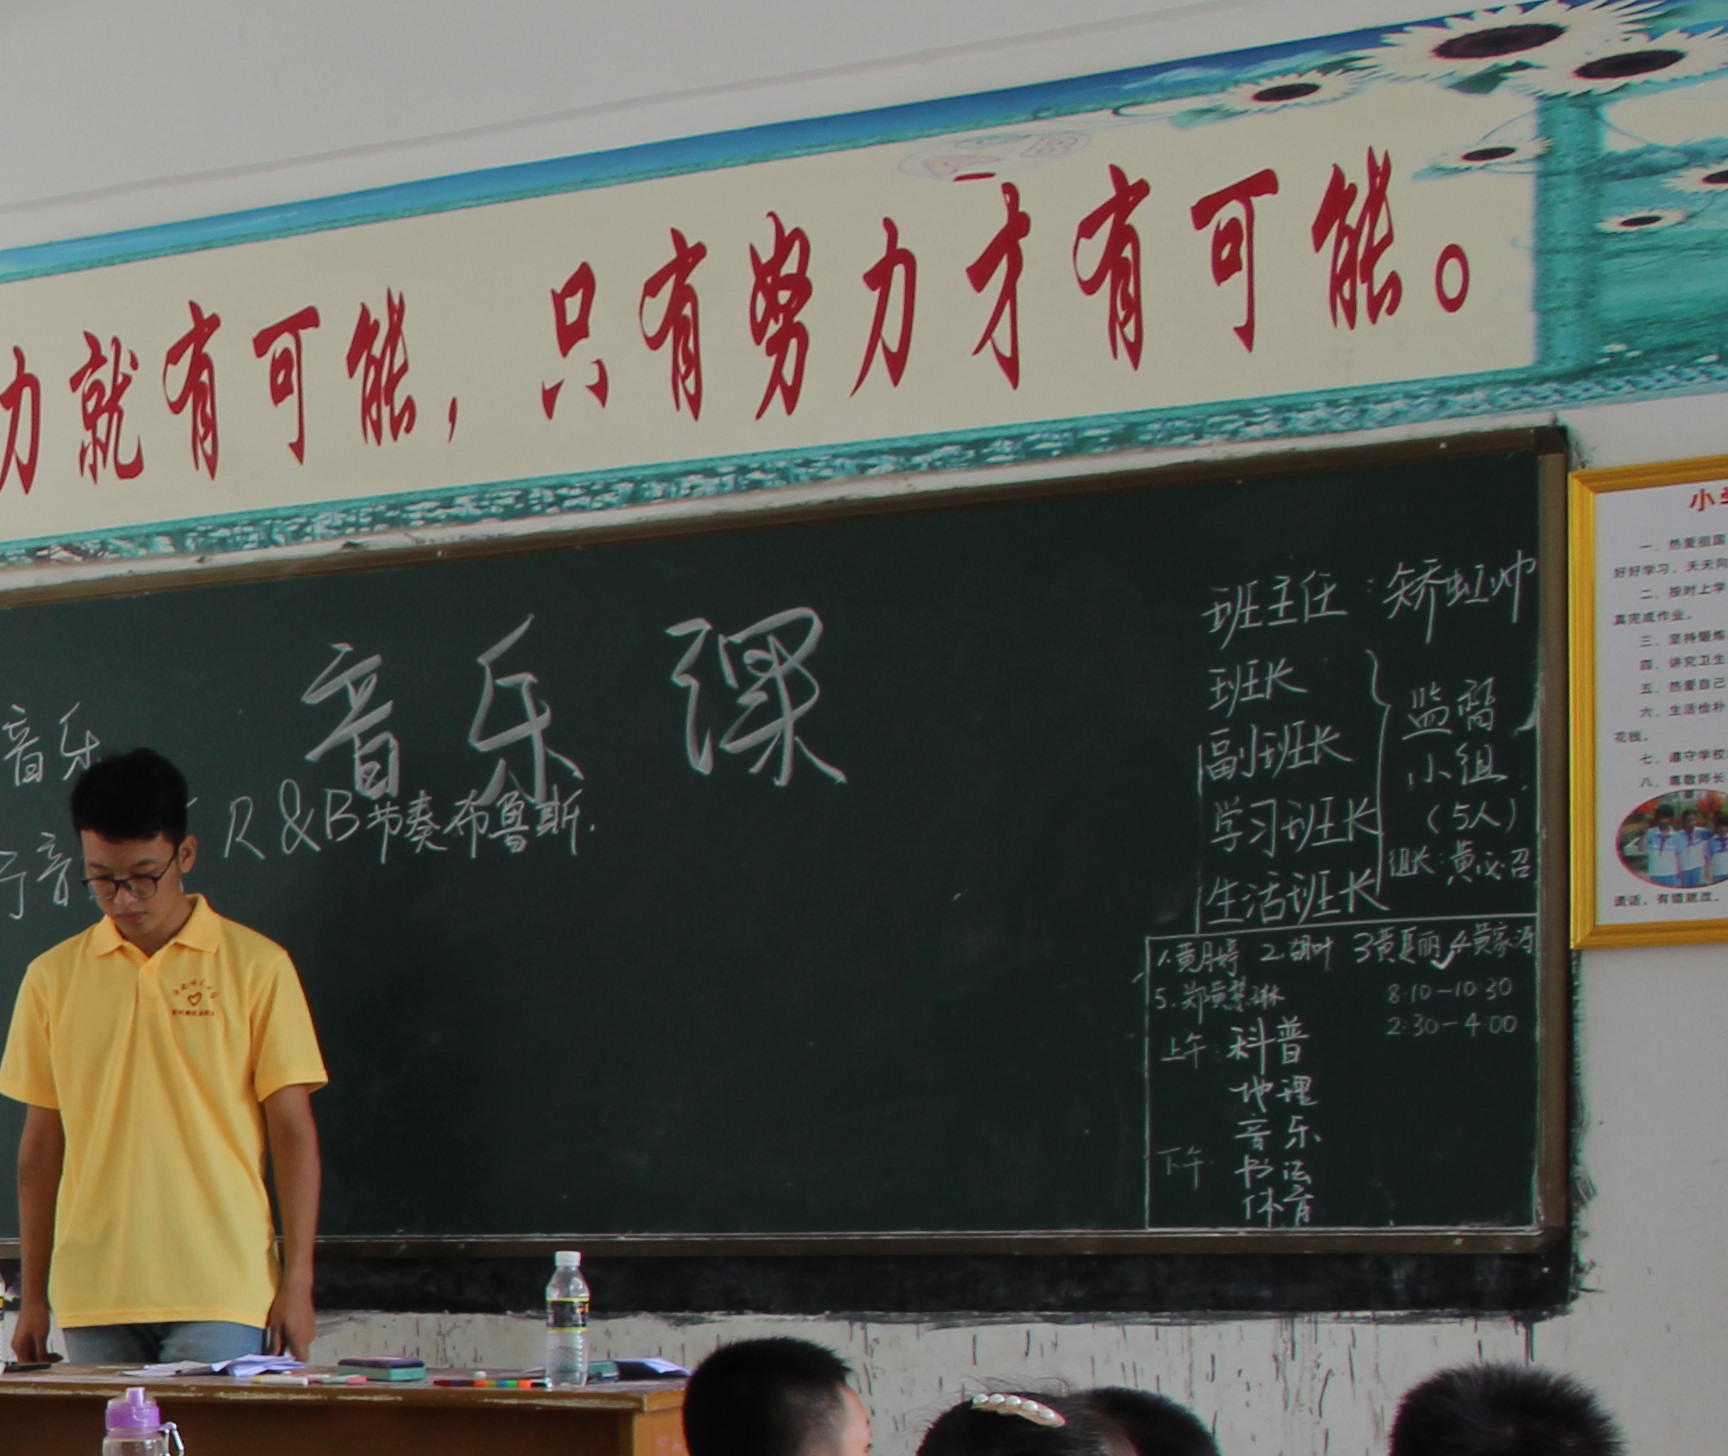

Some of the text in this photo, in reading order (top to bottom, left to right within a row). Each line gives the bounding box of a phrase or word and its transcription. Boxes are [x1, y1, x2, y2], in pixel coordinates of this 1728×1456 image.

[299, 606, 847, 800] 音乐课
[1208, 656, 1308, 717] 班长
[1205, 720, 1354, 780] 副班长
[1408, 743, 1508, 790] 小组
[1210, 796, 1385, 857] 学习班长
[1206, 868, 1390, 925] 生活班长
[1226, 1015, 1310, 1075] 科普
[1228, 1074, 1318, 1112] 地理
[1234, 1115, 1322, 1151] 音乐
[1234, 1154, 1313, 1189] 书法
